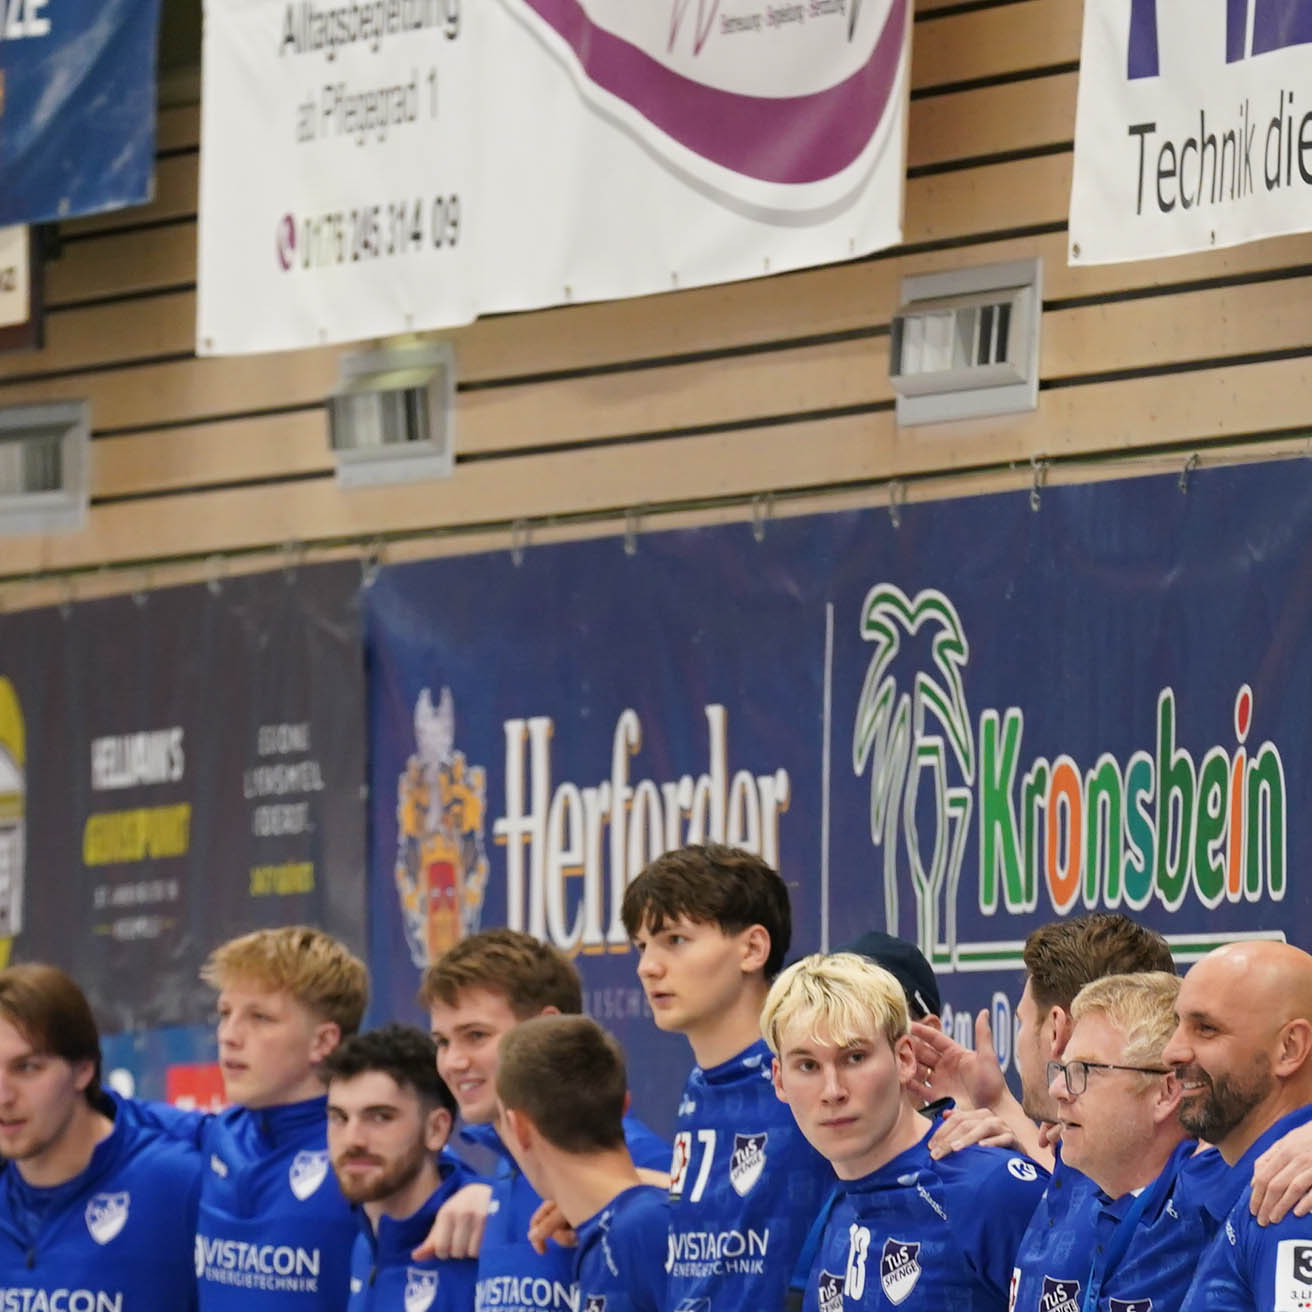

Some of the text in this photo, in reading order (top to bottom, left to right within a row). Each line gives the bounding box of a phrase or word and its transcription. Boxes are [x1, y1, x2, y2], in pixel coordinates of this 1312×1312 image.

[1128, 110, 1255, 216] Technik
[431, 193, 461, 249] 09
[977, 684, 1286, 915] Kronsbein
[201, 1235, 320, 1277] VISTACON
[885, 1245, 910, 1271] TuS
[885, 1263, 918, 1288] SPENGE
[1043, 1284, 1068, 1310] TuS
